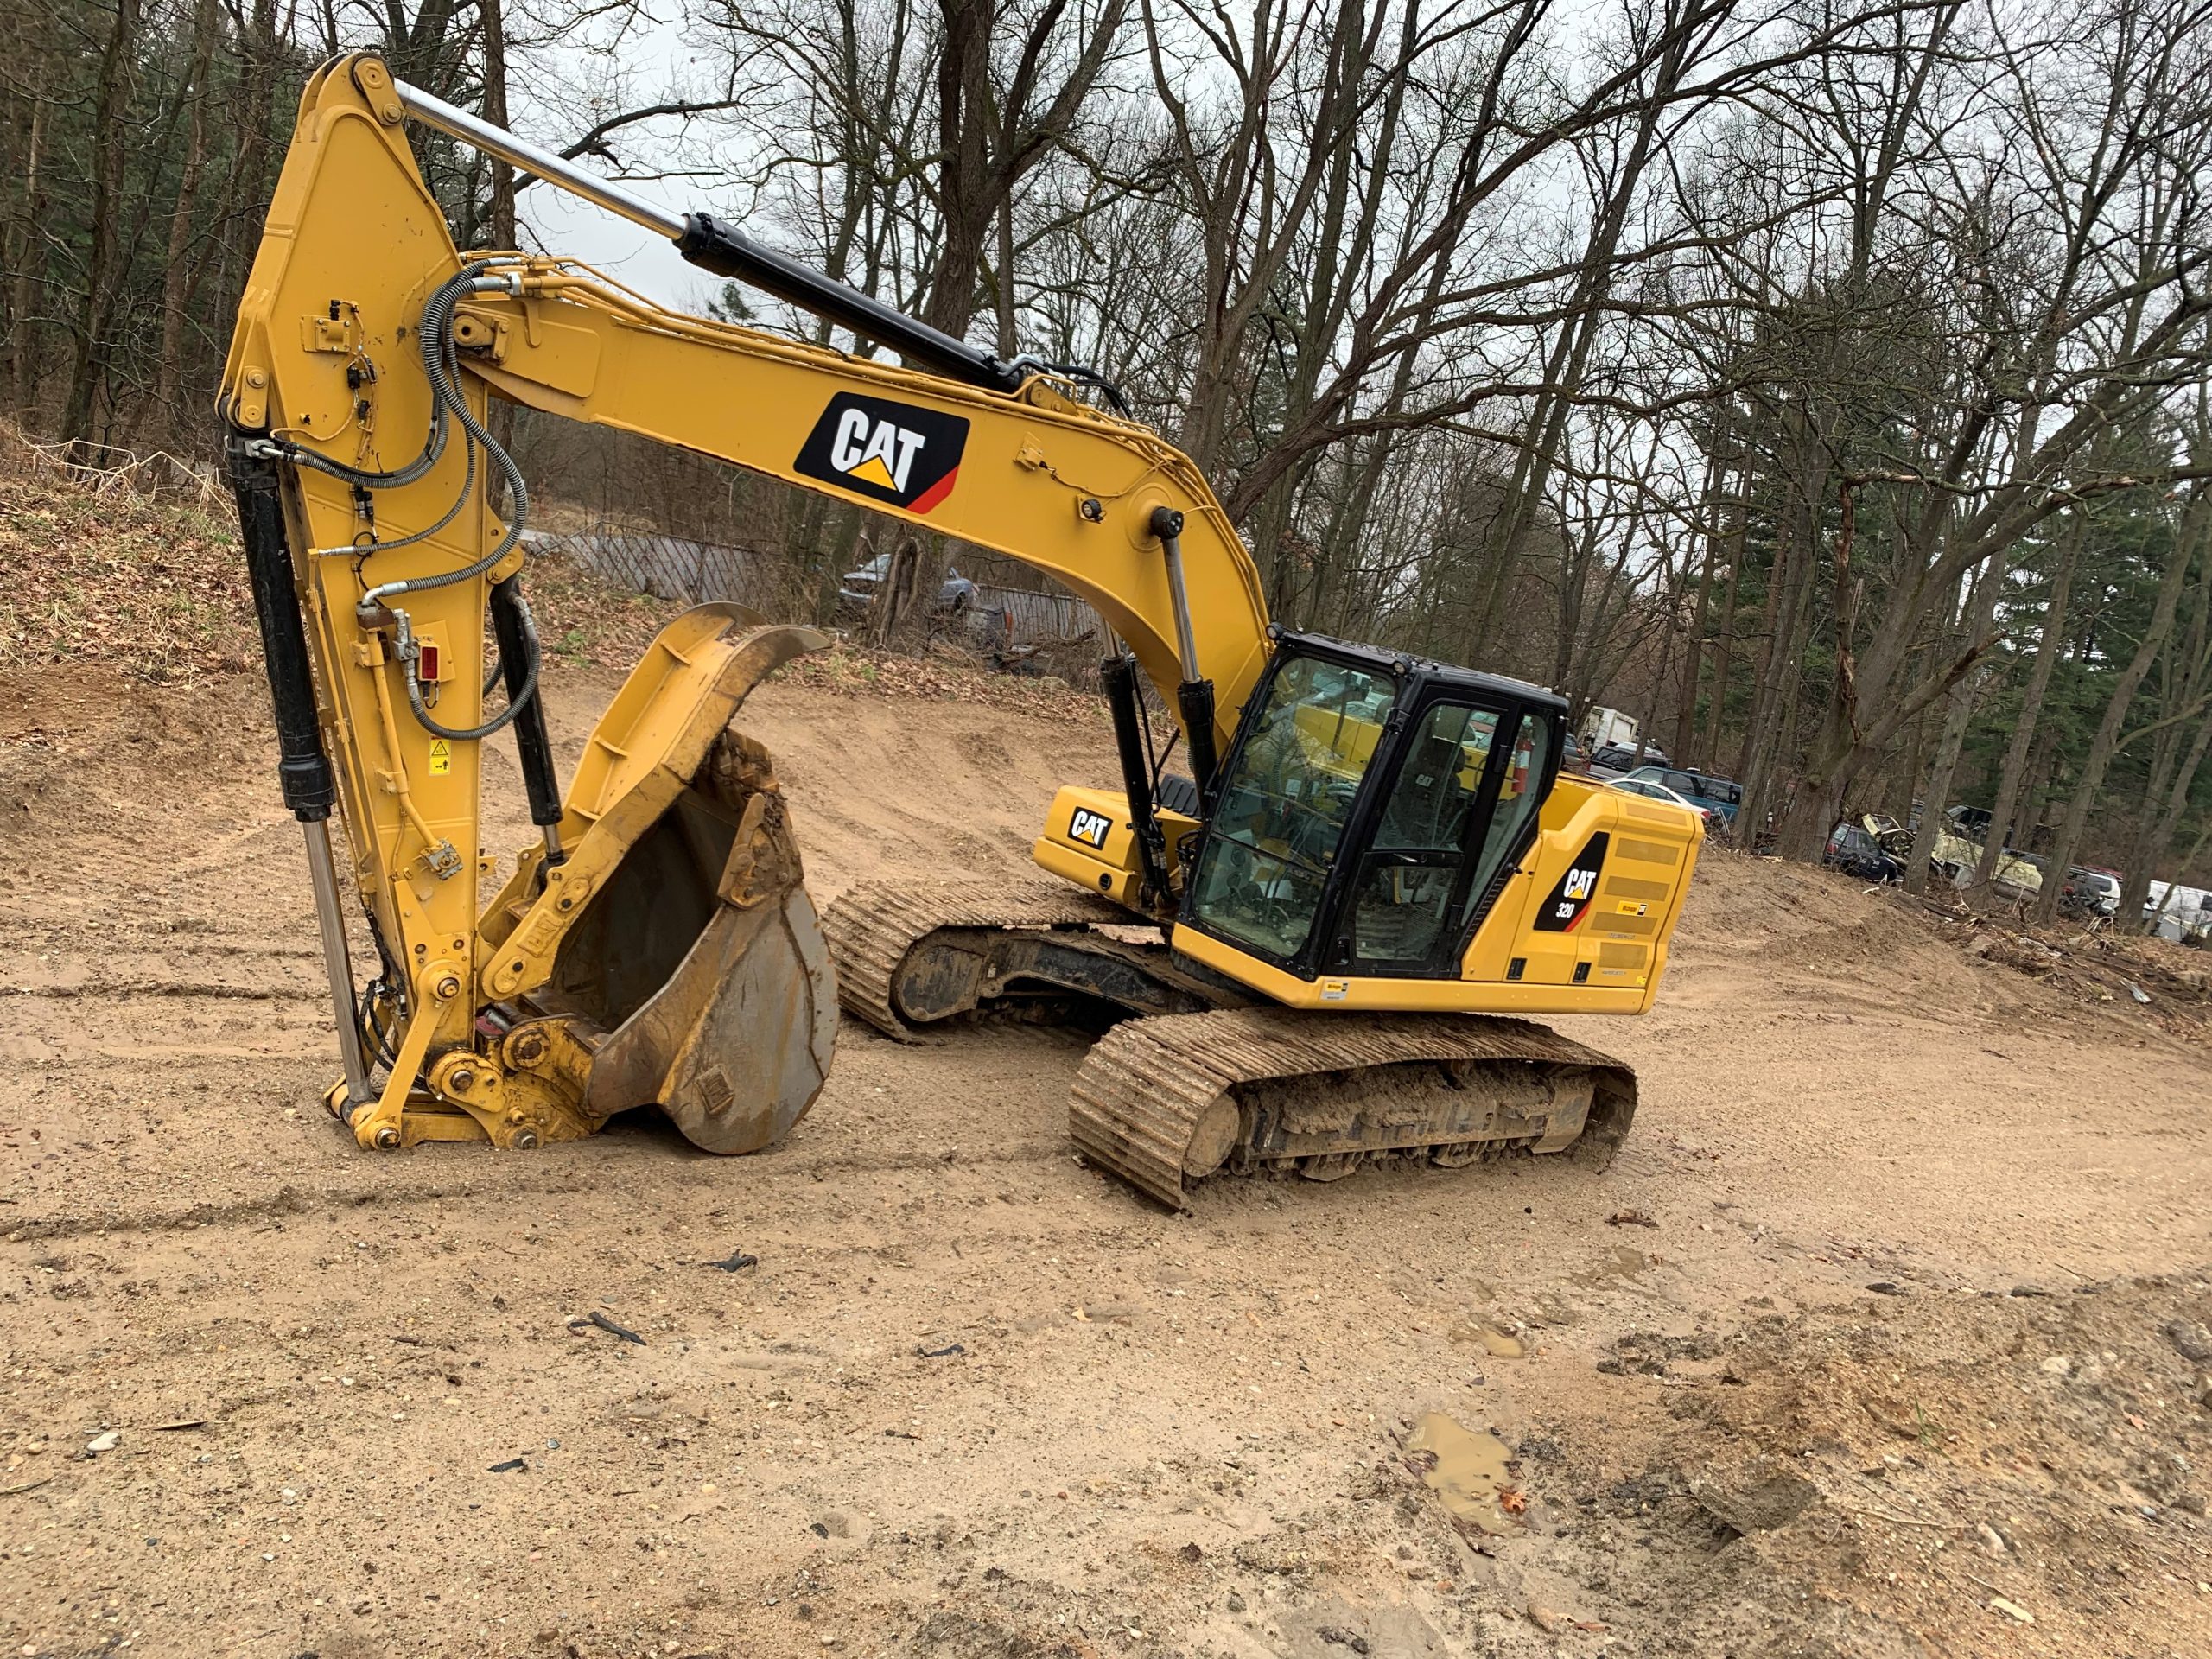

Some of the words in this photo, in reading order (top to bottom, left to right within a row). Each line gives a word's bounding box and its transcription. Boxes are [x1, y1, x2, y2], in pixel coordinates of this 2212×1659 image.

[830, 408, 926, 493] CAT
[1415, 773, 1435, 788] CAT
[1071, 810, 1109, 846] CAT
[1563, 868, 1597, 899] CAT
[1555, 902, 1575, 918] 320
